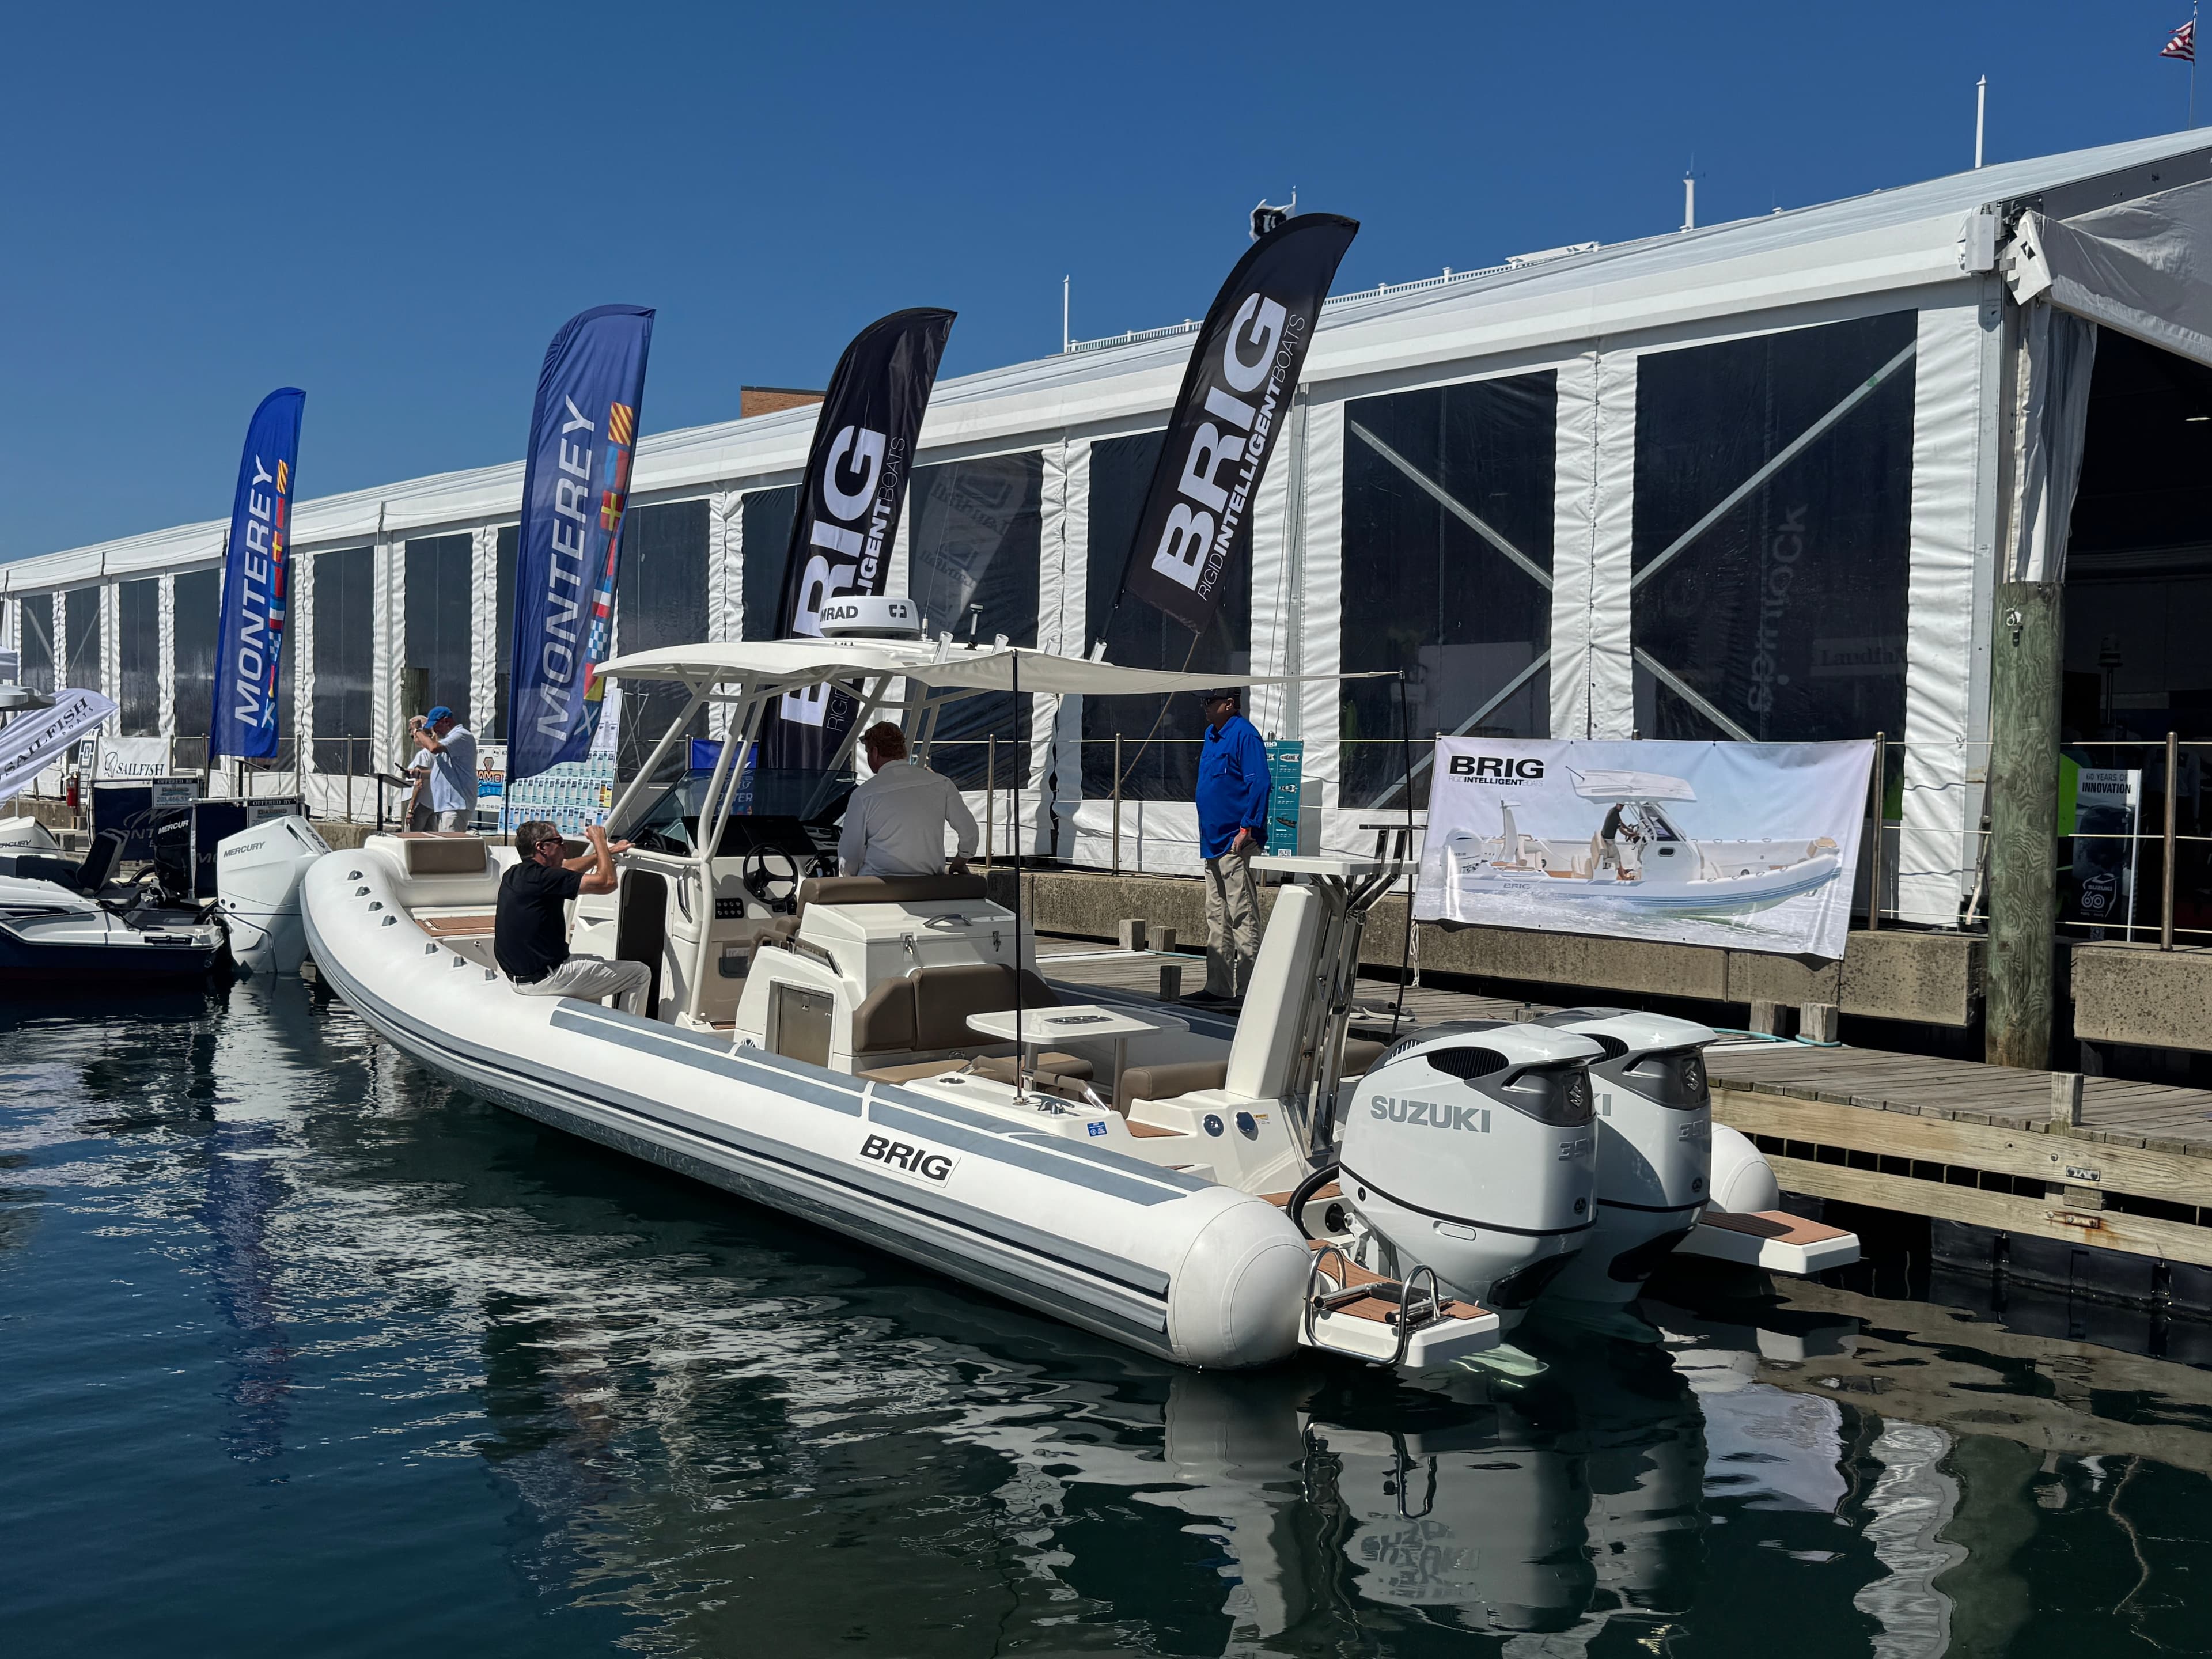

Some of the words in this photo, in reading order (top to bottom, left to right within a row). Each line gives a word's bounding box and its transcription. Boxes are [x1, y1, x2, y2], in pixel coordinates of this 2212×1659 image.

[1152, 292, 1286, 591] BRIG
[537, 394, 594, 741] MONTEREY
[235, 454, 272, 727] MONTEREY
[4, 696, 88, 776] SAILFISH
[116, 762, 164, 776] SAILFISH
[1449, 756, 1544, 778] BRIG
[2082, 782, 2131, 794] INNOVATION
[224, 841, 266, 858] MERCURY
[2081, 891, 2105, 909] 60
[1370, 1095, 1491, 1134] SUZUKI
[861, 1134, 953, 1181] BRIG
